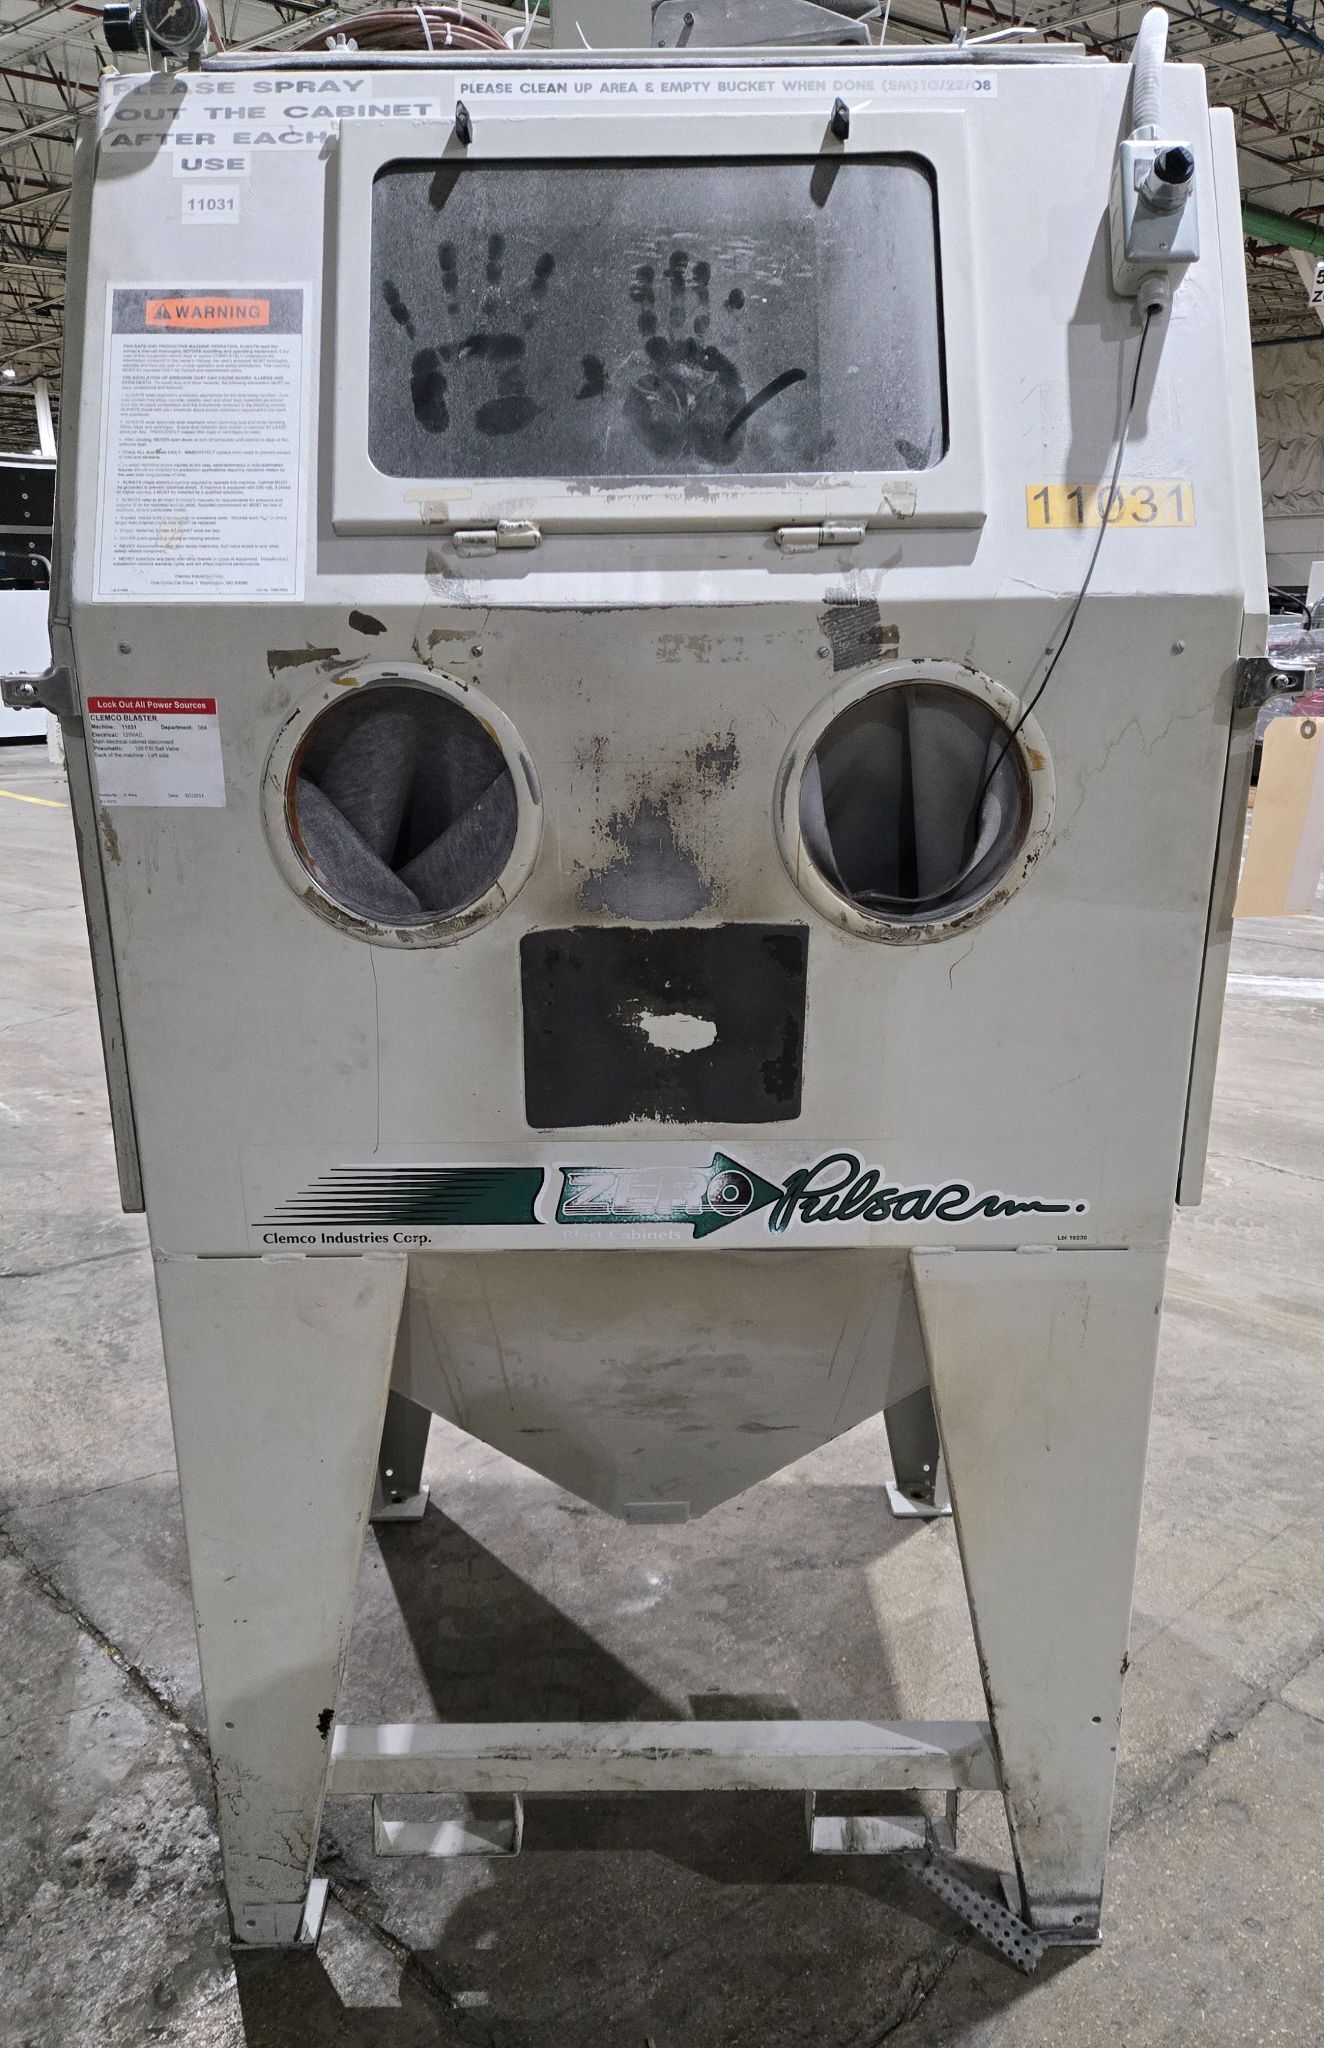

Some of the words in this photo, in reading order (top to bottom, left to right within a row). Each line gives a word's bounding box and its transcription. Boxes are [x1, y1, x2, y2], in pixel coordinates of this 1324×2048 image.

[113, 81, 235, 96] PLEASE
[253, 79, 365, 95] SPRAY
[460, 82, 513, 94] PLEASE
[520, 82, 568, 94] CLEAN
[574, 82, 593, 93] UP
[600, 82, 639, 93] AREA
[661, 81, 711, 93] EMPTY
[718, 81, 775, 92] BUCKET
[782, 80, 828, 92] WHEN
[833, 80, 875, 91] DONE
[114, 107, 187, 121] OUT
[203, 106, 267, 120] THE
[283, 104, 433, 119] CABINET
[110, 132, 216, 147] AFTER
[233, 130, 327, 145] EACH
[181, 158, 245, 171] USE
[187, 198, 235, 211] 11031
[175, 305, 261, 319] WARNING
[1033, 484, 1184, 524] 11031
[97, 700, 117, 709] Lock
[119, 700, 133, 709] Out
[135, 701, 146, 709] All
[147, 701, 172, 709] Power
[174, 701, 207, 710] Sources
[263, 1232, 317, 1244] Clemco
[321, 1232, 389, 1244] Industries
[392, 1232, 432, 1246] Corp.
